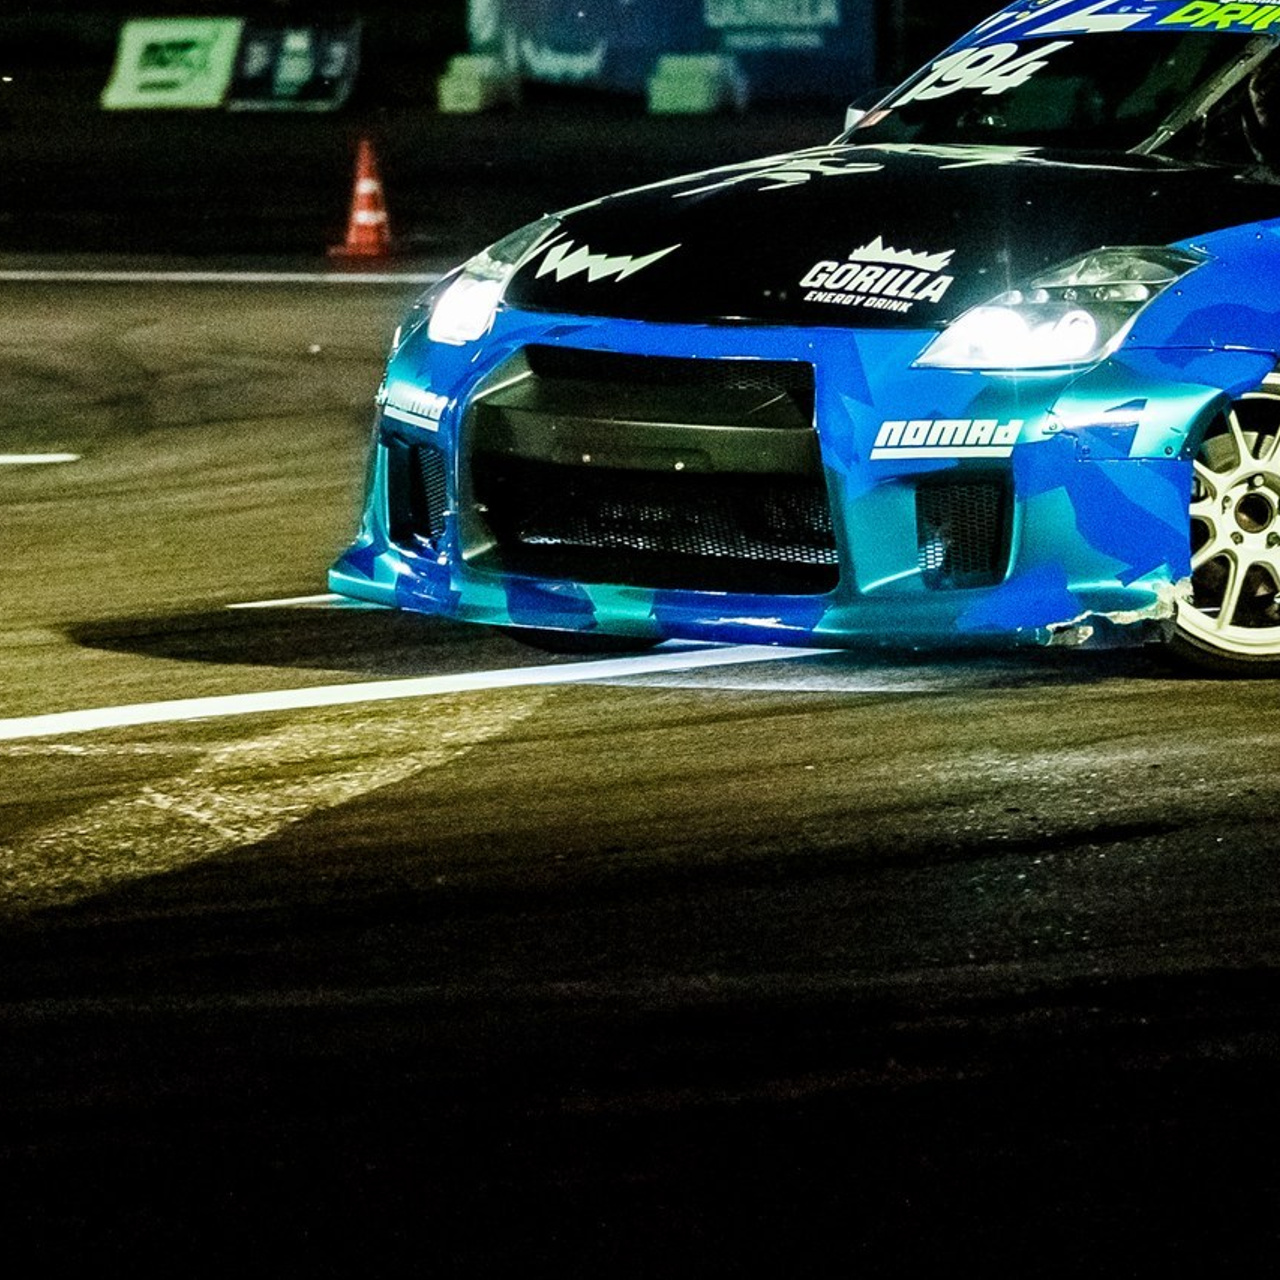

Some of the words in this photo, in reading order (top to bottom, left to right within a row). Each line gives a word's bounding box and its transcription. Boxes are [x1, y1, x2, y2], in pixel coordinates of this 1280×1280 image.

[889, 41, 1075, 108] 194
[799, 260, 954, 303] GORILLA
[803, 290, 865, 307] ENERGY
[862, 296, 913, 313] DRINK
